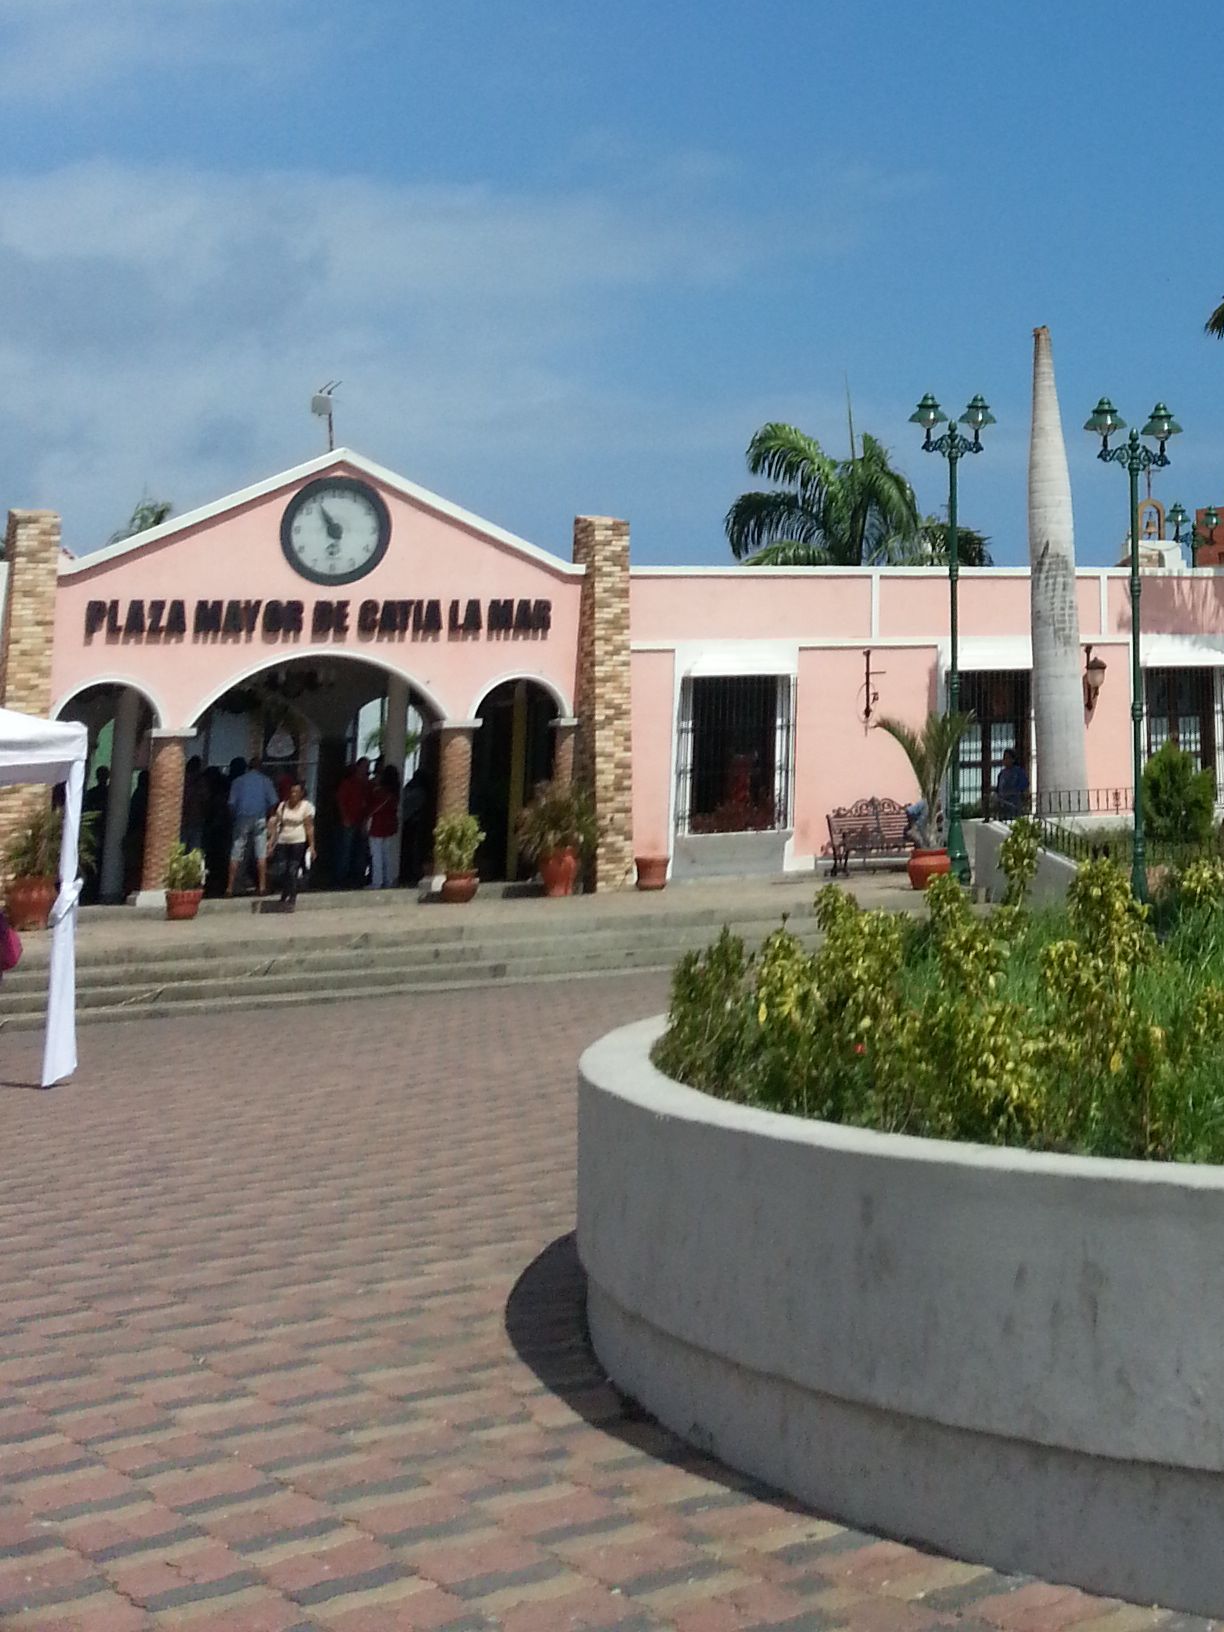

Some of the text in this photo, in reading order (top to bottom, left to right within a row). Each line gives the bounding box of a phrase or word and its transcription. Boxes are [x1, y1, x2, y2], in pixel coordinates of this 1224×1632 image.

[85, 599, 552, 636] PLAZA MAYOR DE CATIA LA MAR
